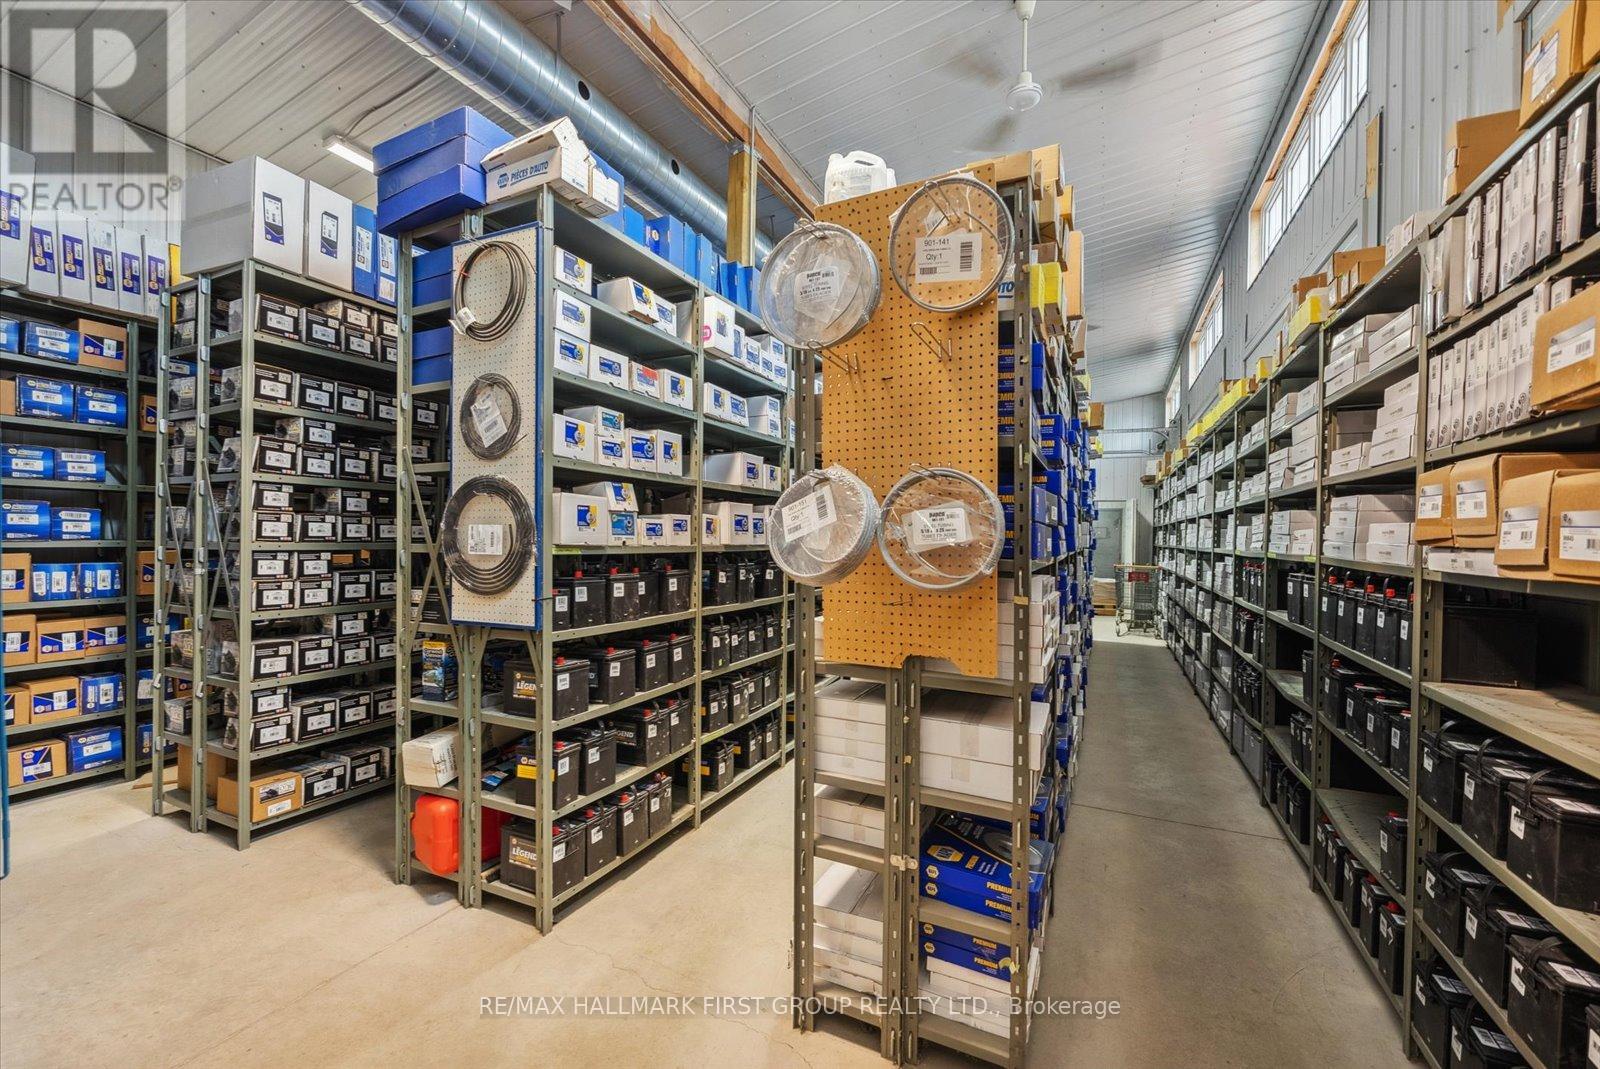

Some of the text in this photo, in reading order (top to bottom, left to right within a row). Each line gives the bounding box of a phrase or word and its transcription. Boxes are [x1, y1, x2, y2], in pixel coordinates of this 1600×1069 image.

[529, 161, 549, 175] D'AUTO
[923, 238, 950, 247] 901-141
[973, 937, 997, 949] PREMIUM
[974, 957, 998, 969] PREMIUM
